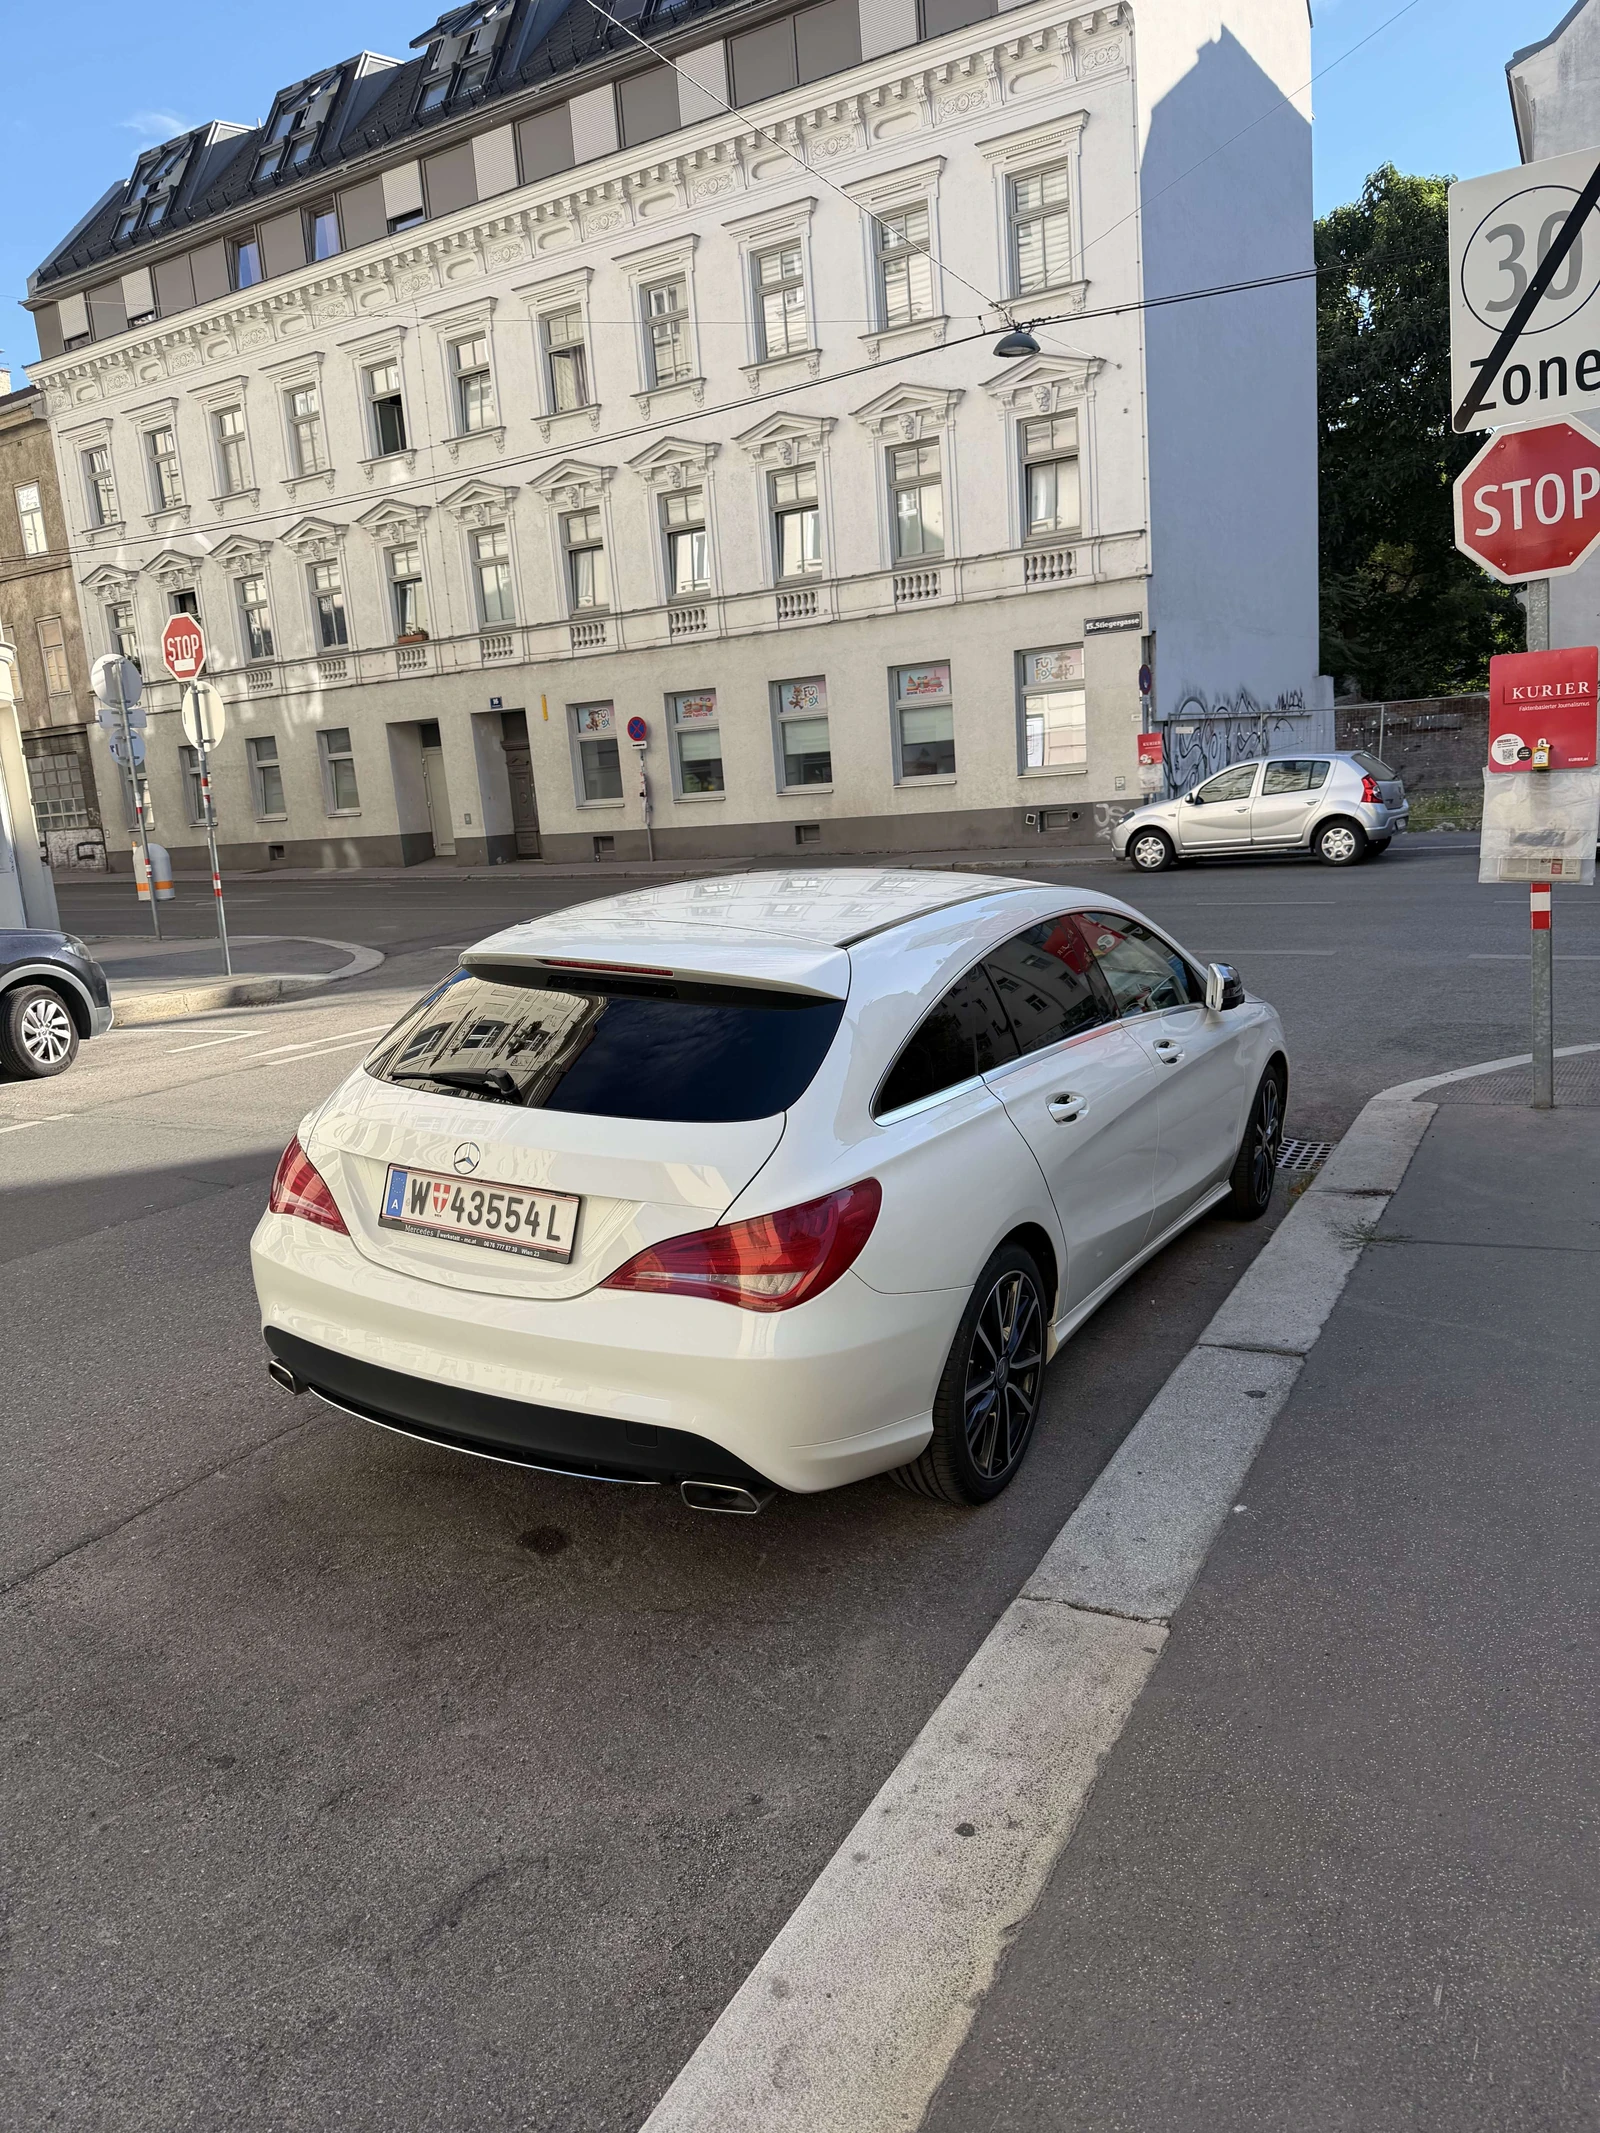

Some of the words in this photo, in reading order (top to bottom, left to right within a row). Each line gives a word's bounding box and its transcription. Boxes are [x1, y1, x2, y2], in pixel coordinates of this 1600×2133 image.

[1484, 210, 1583, 313] 30
[1470, 349, 1600, 412] Zone
[1473, 466, 1600, 537] STOP
[167, 634, 200, 661] STOP
[1512, 681, 1591, 700] KURIER
[1518, 703, 1557, 712] Faktenbasierter
[1557, 701, 1590, 709] Journalismus
[391, 1198, 399, 1210] A
[410, 1178, 432, 1216] W
[404, 1224, 434, 1237] Mercedes
